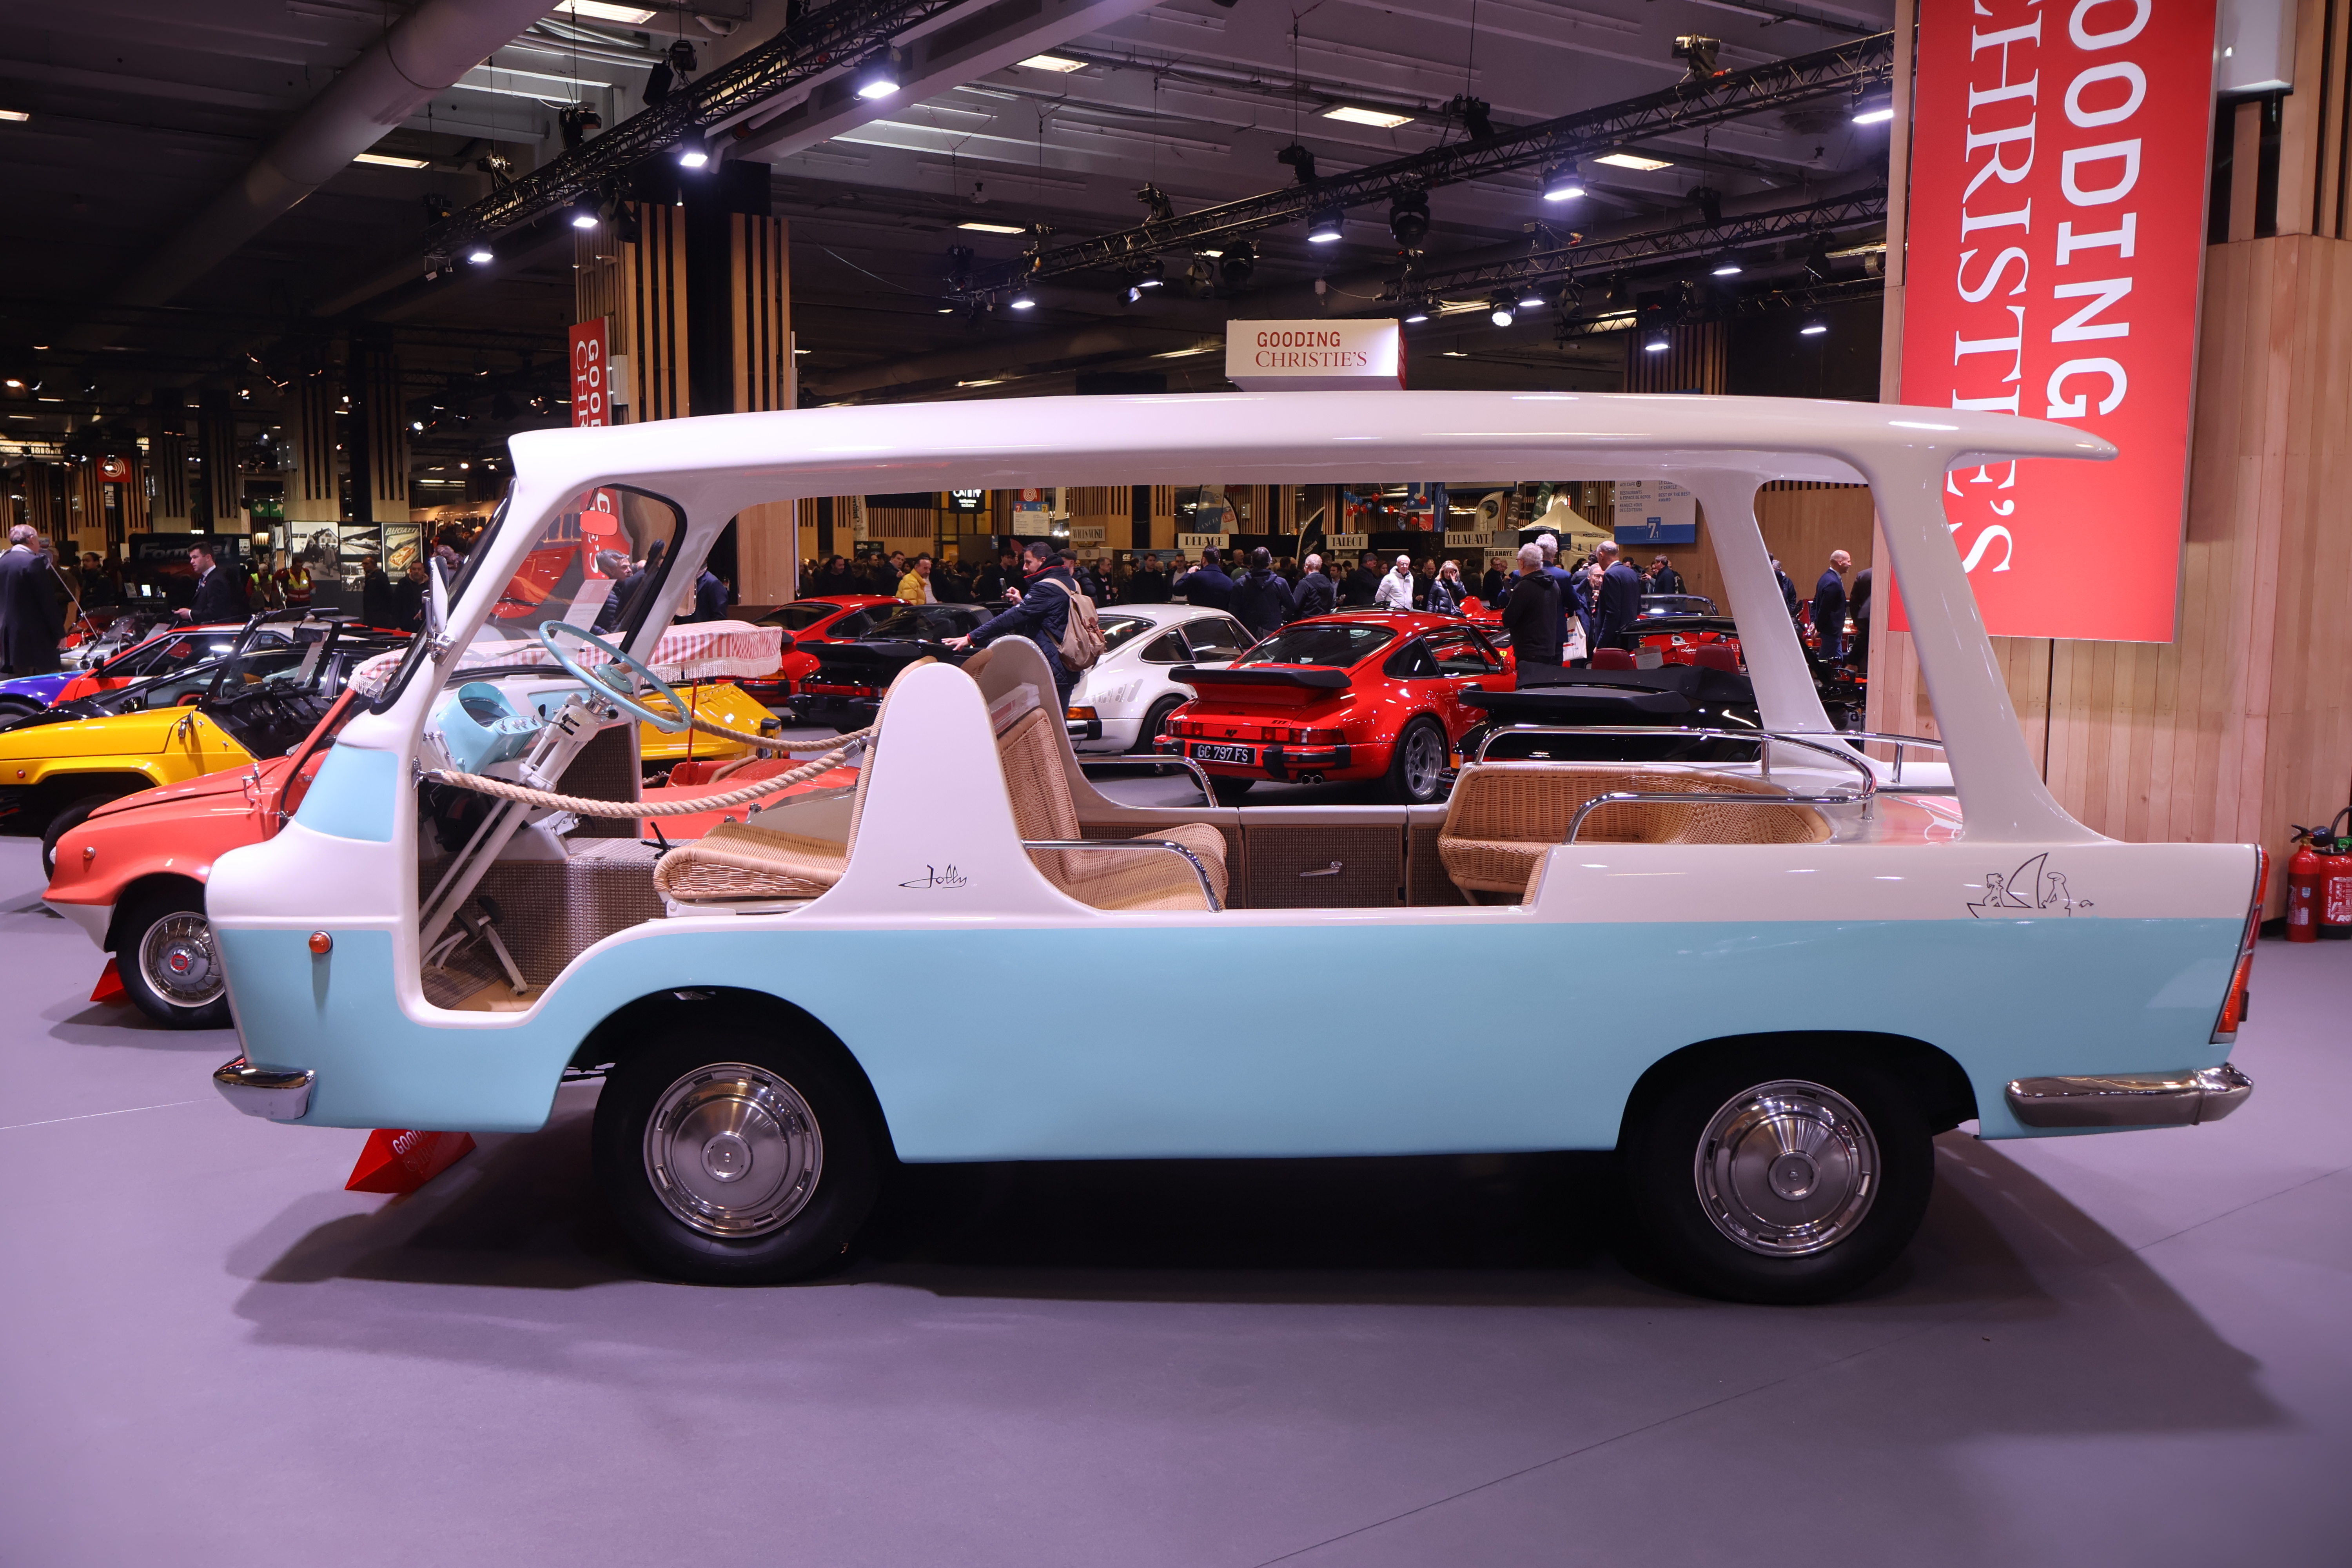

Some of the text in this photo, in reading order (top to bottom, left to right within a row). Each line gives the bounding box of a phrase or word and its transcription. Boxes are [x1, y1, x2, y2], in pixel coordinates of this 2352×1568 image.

[2047, 0, 2151, 419] OODING
[1257, 331, 1341, 347] GOODING
[1256, 350, 1367, 367] CHRISTIE'S
[385, 527, 419, 535] BUGATTI
[1197, 517, 1219, 532] LANCIA
[1648, 523, 1659, 539] 7.1
[1185, 536, 1223, 546] DELAGE
[1331, 537, 1363, 546] TALBOT
[1447, 534, 1490, 544] DELAHAYE
[1197, 745, 1248, 762] GC 797 FS
[898, 864, 967, 889] Jolly
